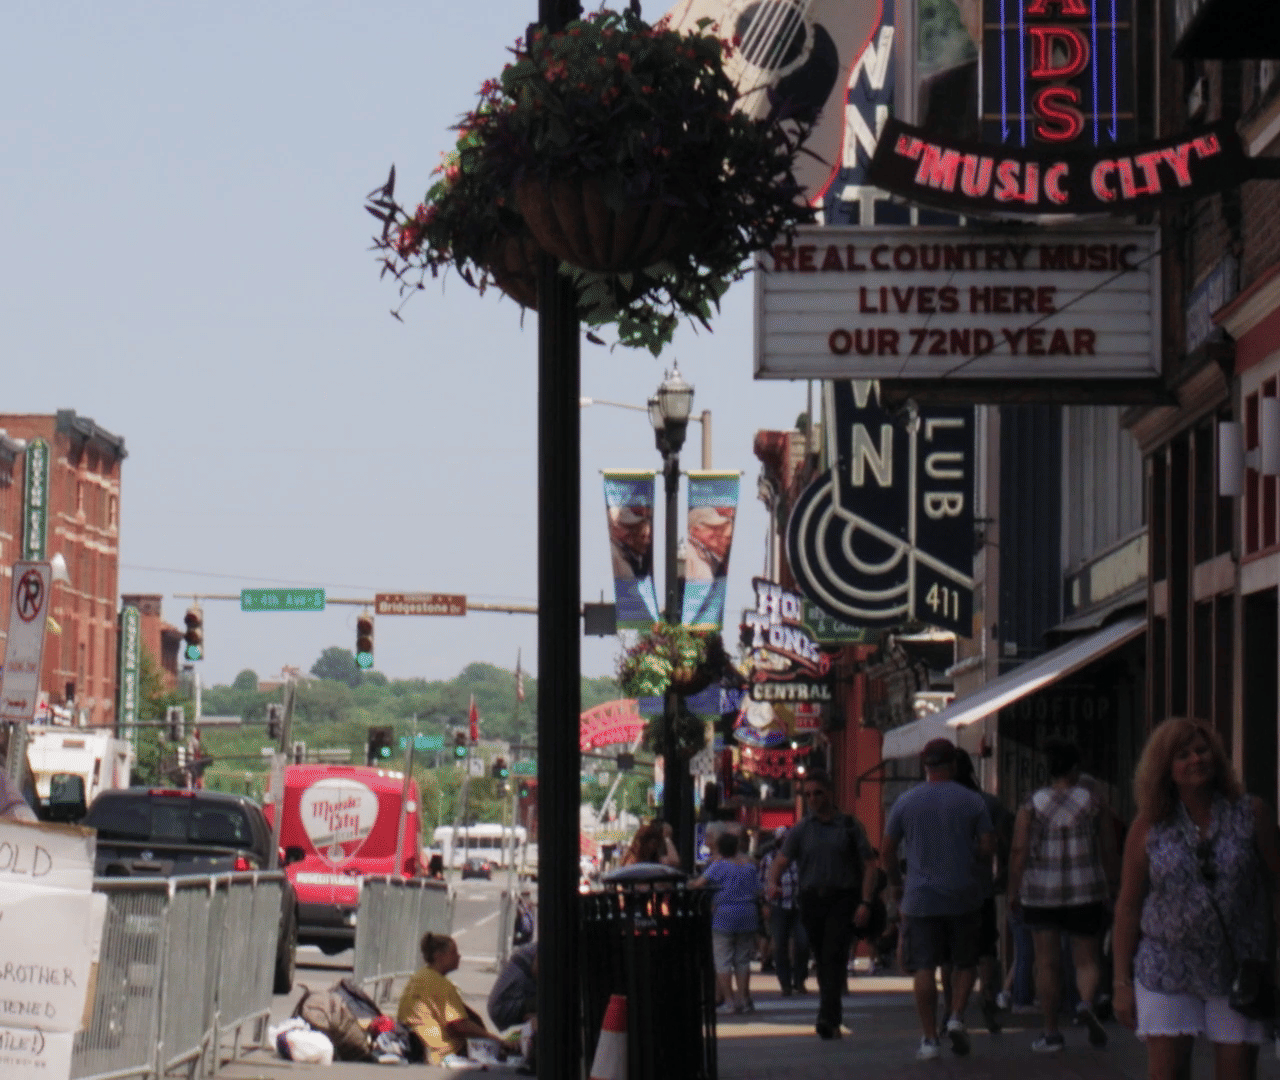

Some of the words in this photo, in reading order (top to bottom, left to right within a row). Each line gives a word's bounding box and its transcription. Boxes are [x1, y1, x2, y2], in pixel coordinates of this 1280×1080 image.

[1039, 244, 1139, 272] MUSIC
[858, 286, 960, 315] LIVES
[969, 286, 1057, 315] HERE
[827, 328, 899, 357] OUR
[907, 328, 995, 357] 72ND
[999, 328, 1098, 357] YEAR
[923, 417, 966, 519] LUB
[924, 582, 960, 621] 411
[753, 682, 833, 701] CENTRAL
[312, 796, 358, 822] Music
[328, 812, 360, 837] City
